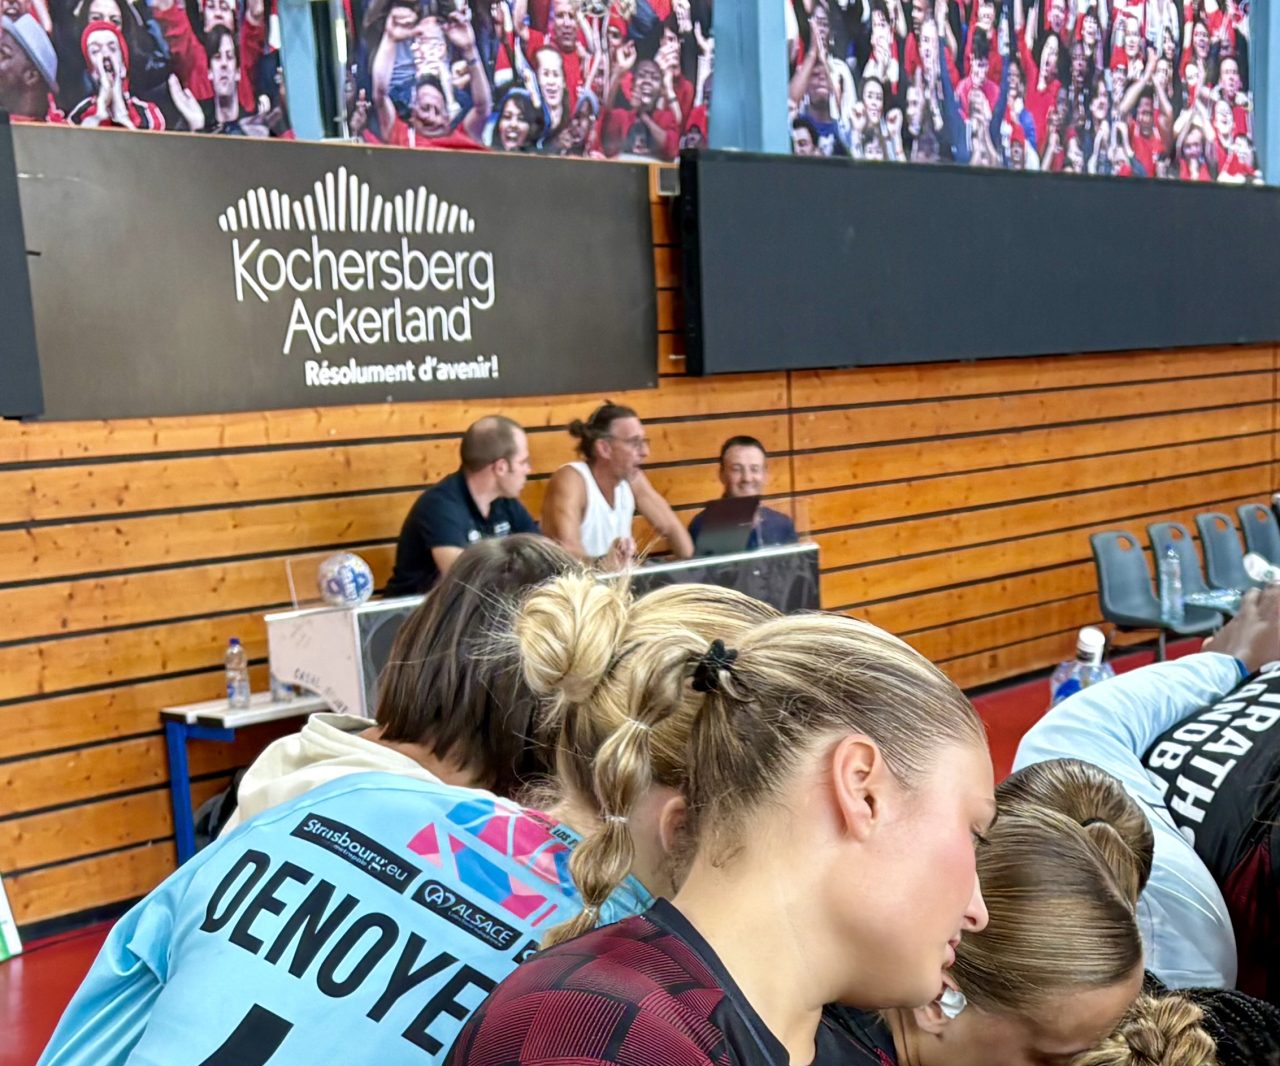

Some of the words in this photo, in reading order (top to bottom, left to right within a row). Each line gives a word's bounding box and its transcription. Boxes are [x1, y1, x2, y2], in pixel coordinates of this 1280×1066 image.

[232, 234, 496, 311] Kochersberg
[282, 296, 473, 355] Ackerland
[304, 356, 416, 387] Résolument
[417, 354, 500, 382] d'avenir!
[303, 817, 408, 882] Strasbourg.eu
[200, 848, 500, 1057] DENOYE
[452, 903, 514, 944] ALSACE
